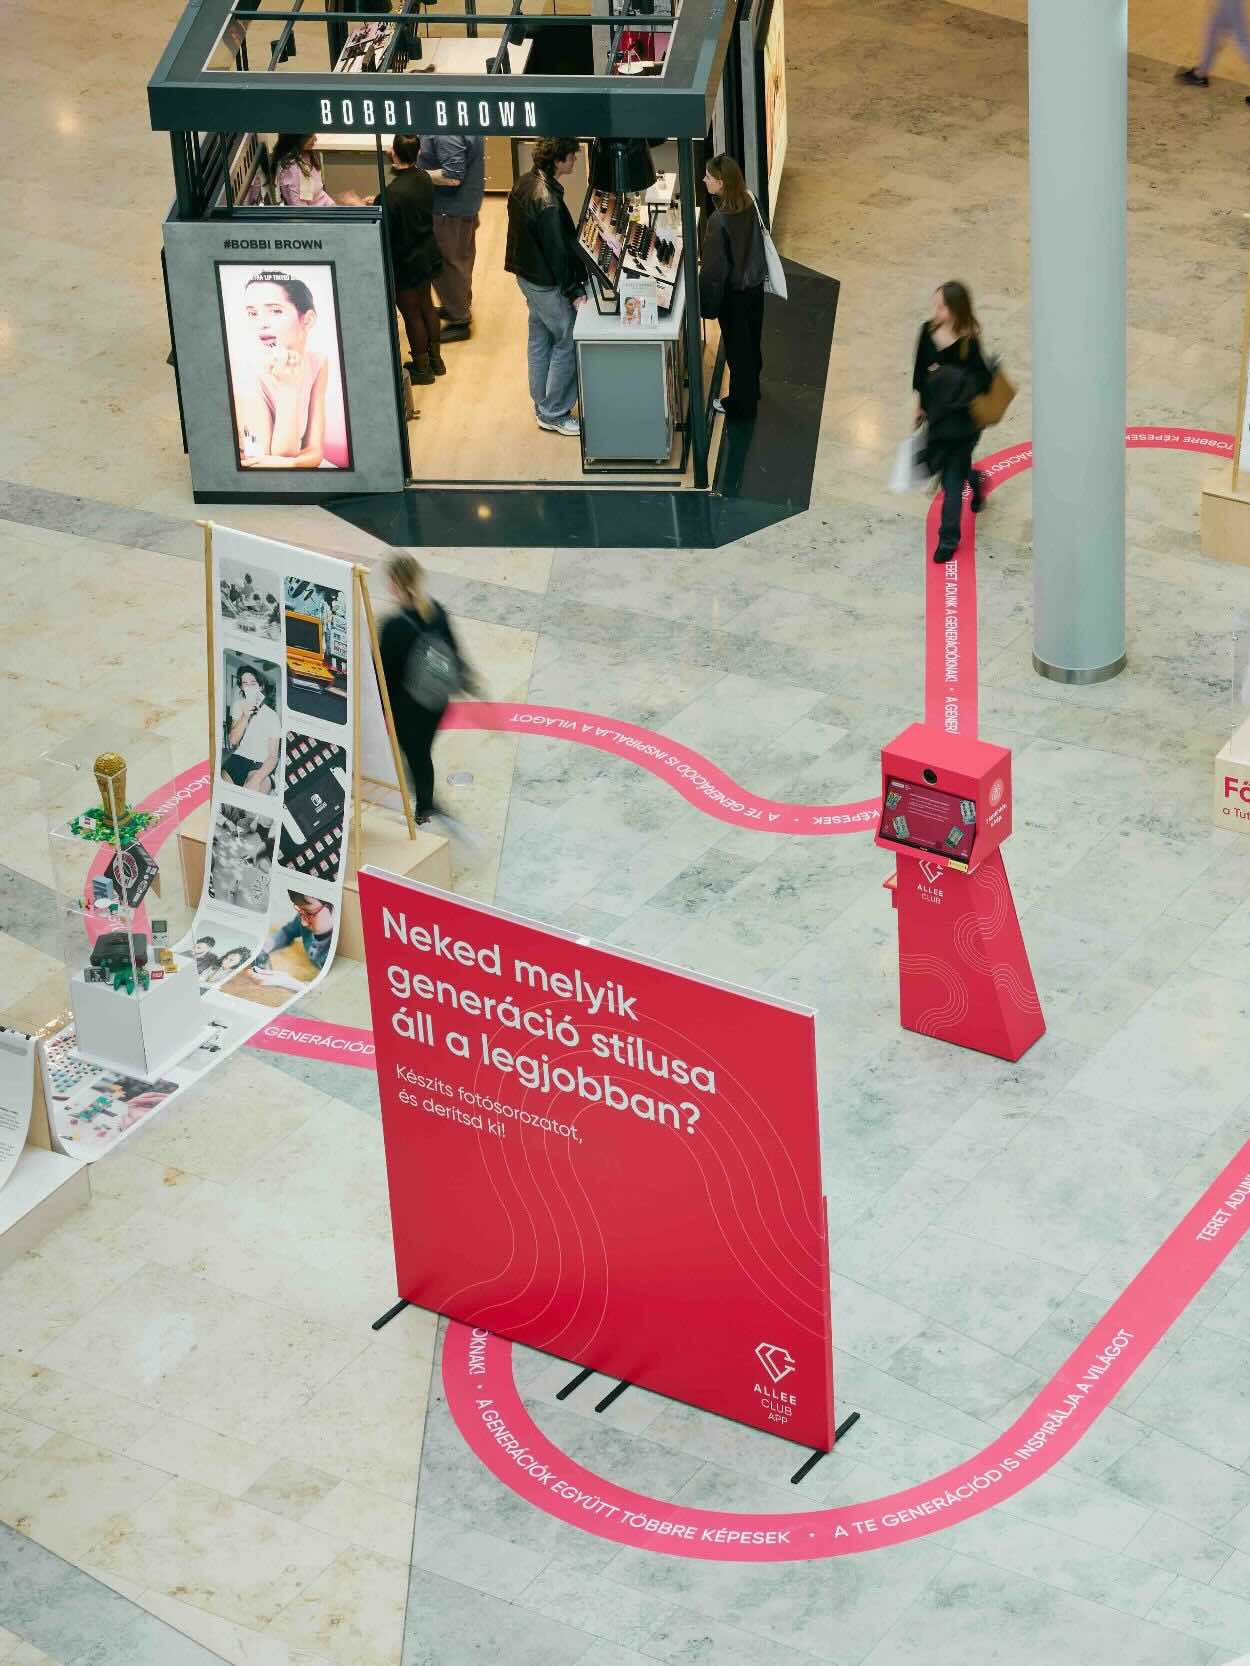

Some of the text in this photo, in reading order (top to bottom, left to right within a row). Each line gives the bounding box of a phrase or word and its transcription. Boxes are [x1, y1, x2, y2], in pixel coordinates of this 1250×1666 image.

[320, 99, 537, 127] BOBBI BROWN
[223, 239, 323, 250] #BOBBI BROWN
[510, 713, 577, 729] VILÁGOT
[581, 724, 595, 733] A
[595, 727, 666, 760] INSPIRÁLJA
[664, 755, 681, 767] IS
[675, 763, 745, 812] GENERÁCIÓD
[744, 807, 764, 820] TE
[767, 812, 781, 822] A
[1222, 806, 1231, 816] a
[916, 884, 944, 897] ALLEE
[921, 893, 941, 904] CLUB
[381, 907, 640, 1022] Neked melyik
[264, 1026, 376, 1055] GENERÁCIÓD
[386, 964, 717, 1095] generáció stílusa
[391, 1007, 701, 1136] áll a legjobban?
[398, 1088, 418, 1107] és
[487, 1118, 506, 1138] ki!
[457, 1086, 584, 1145] fotósorozatot,
[1196, 1208, 1233, 1241] TERET
[753, 1383, 797, 1406] ALLEE
[760, 1398, 793, 1417] CLUB
[768, 1412, 788, 1425] APP
[833, 1327, 1136, 1539] A TE GENERÁCIÓD IS INSPIRÁLJA A VILÁGOT
[475, 1399, 791, 1545] A GENERÁCIÓK EGYÜTT TÖBBRE KÉPESEK
